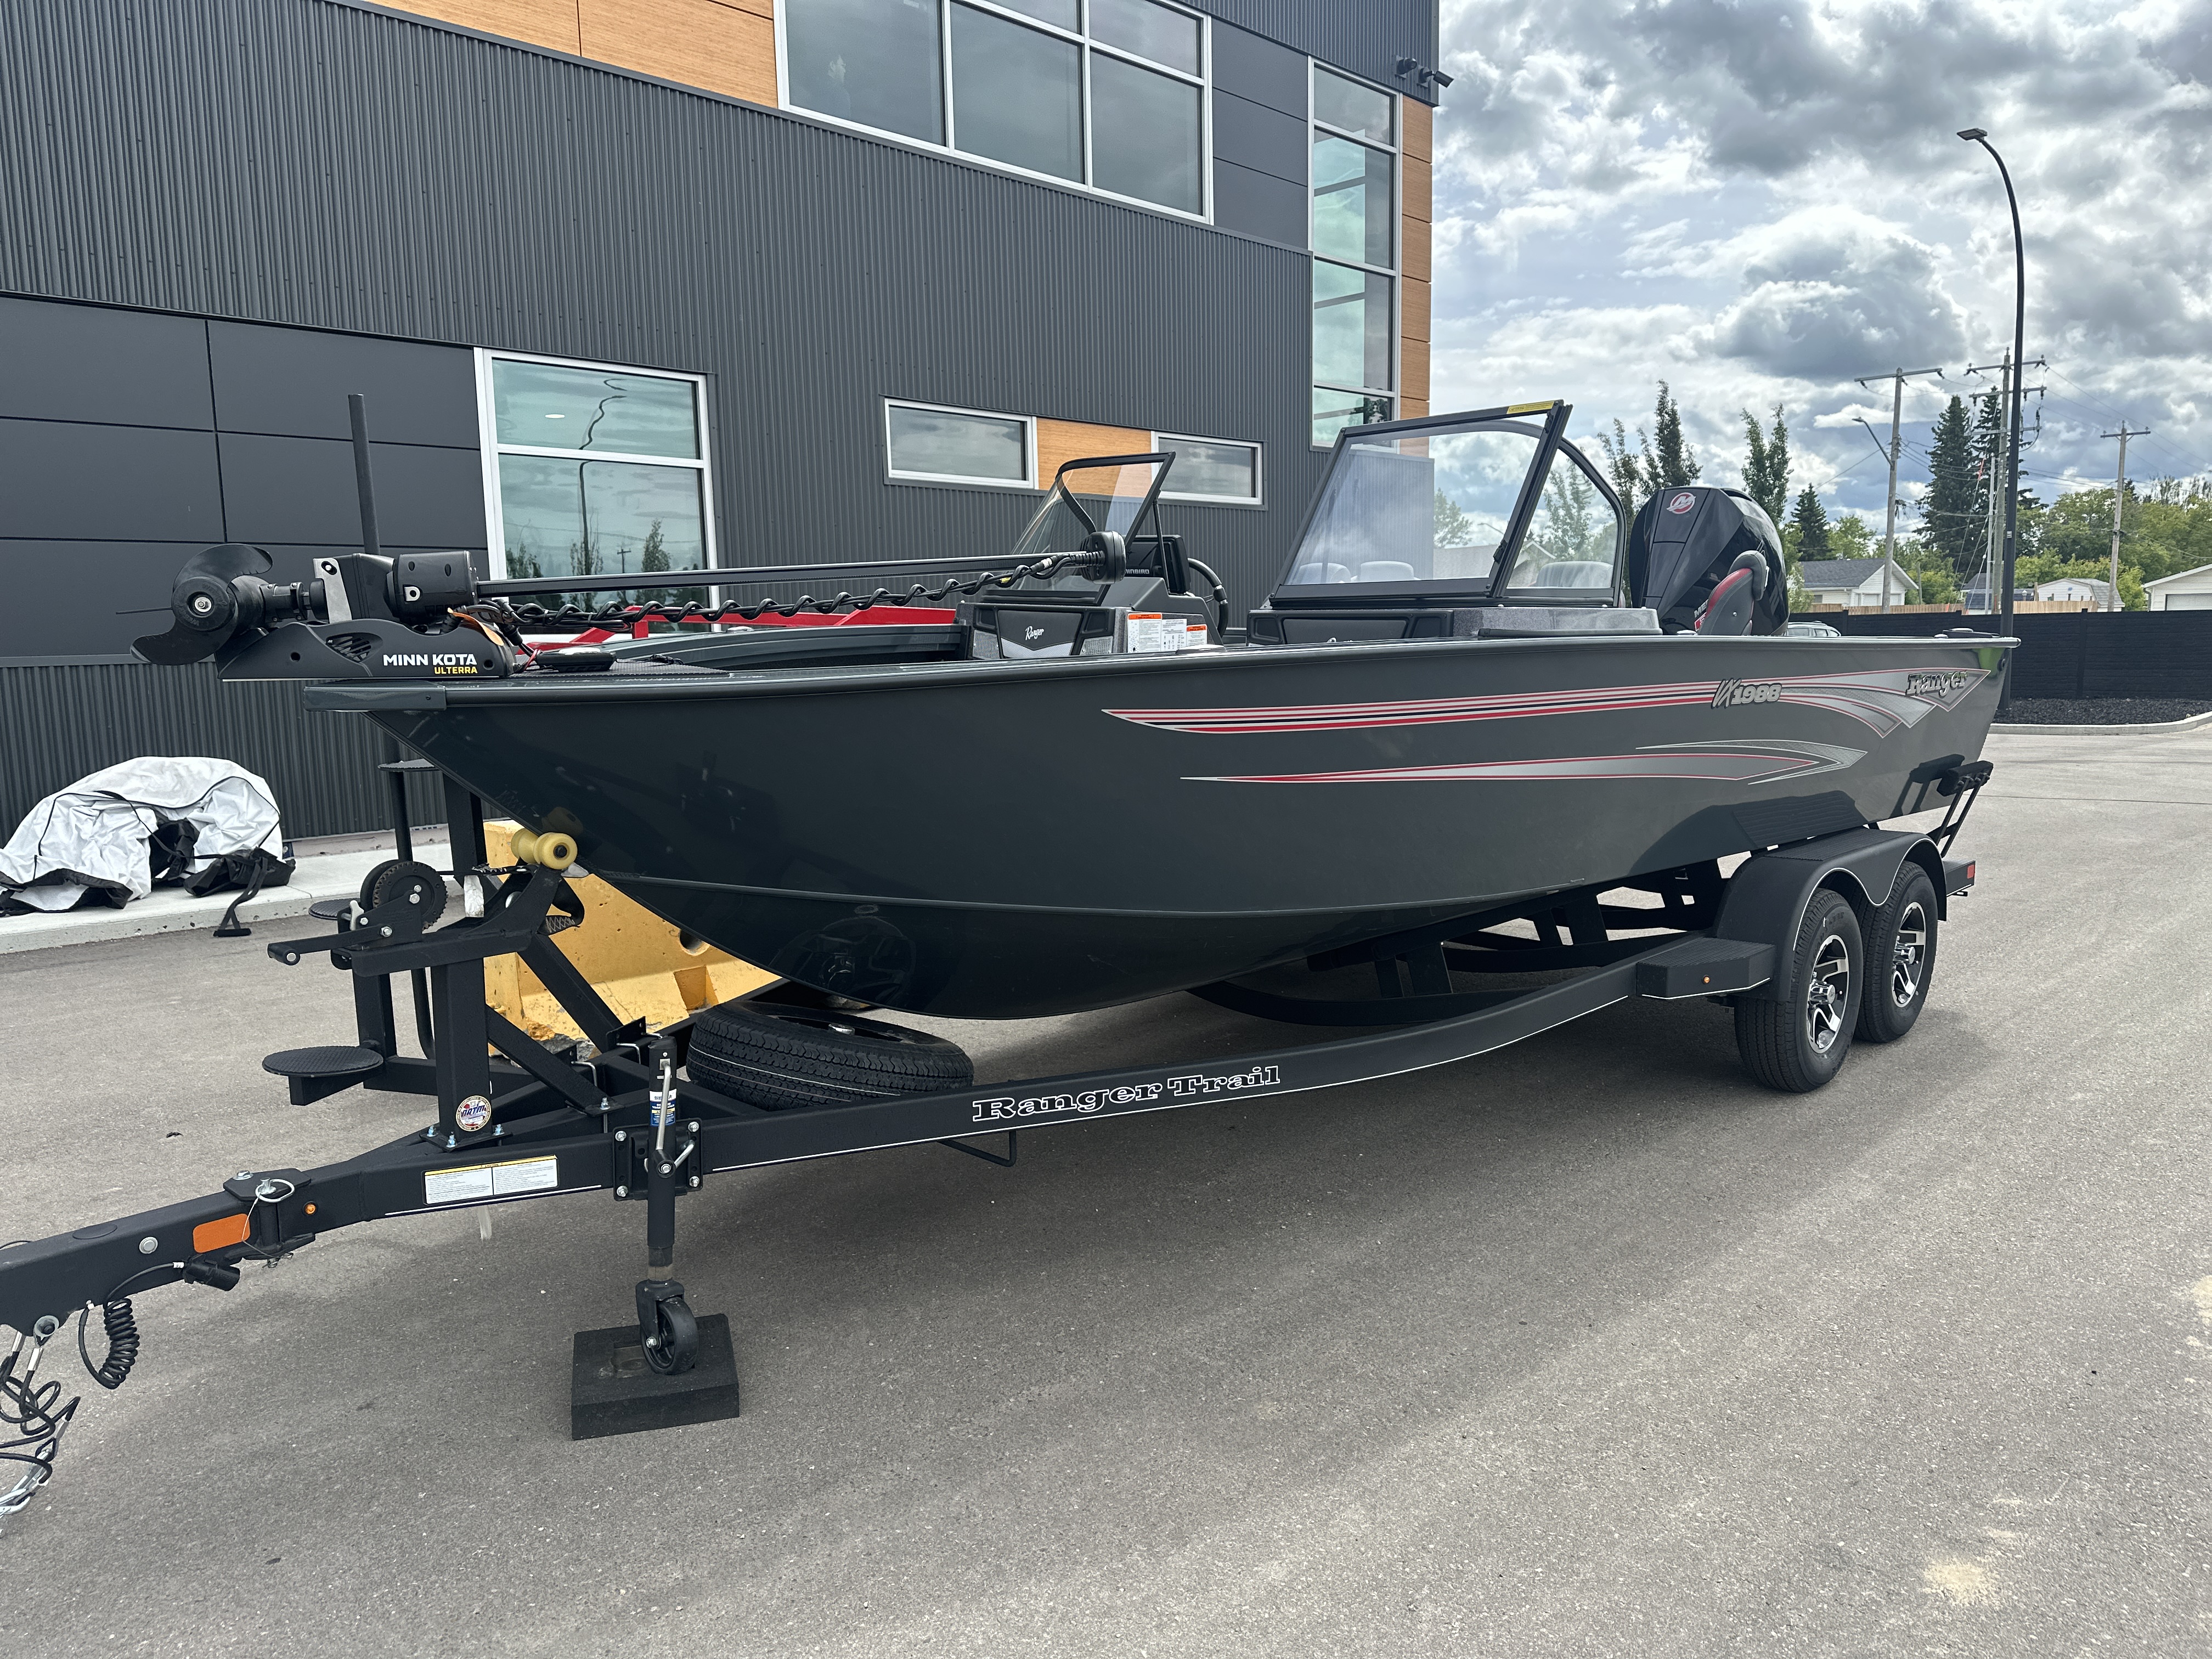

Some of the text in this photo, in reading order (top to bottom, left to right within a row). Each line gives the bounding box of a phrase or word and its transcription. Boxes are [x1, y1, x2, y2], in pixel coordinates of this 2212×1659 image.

[1025, 625, 1045, 641] Ranger
[383, 653, 477, 666] MINN KOTA
[434, 666, 478, 674] ULTERRA
[1905, 670, 1968, 698] Ranger
[972, 1065, 1280, 1122] Ranger Trail
